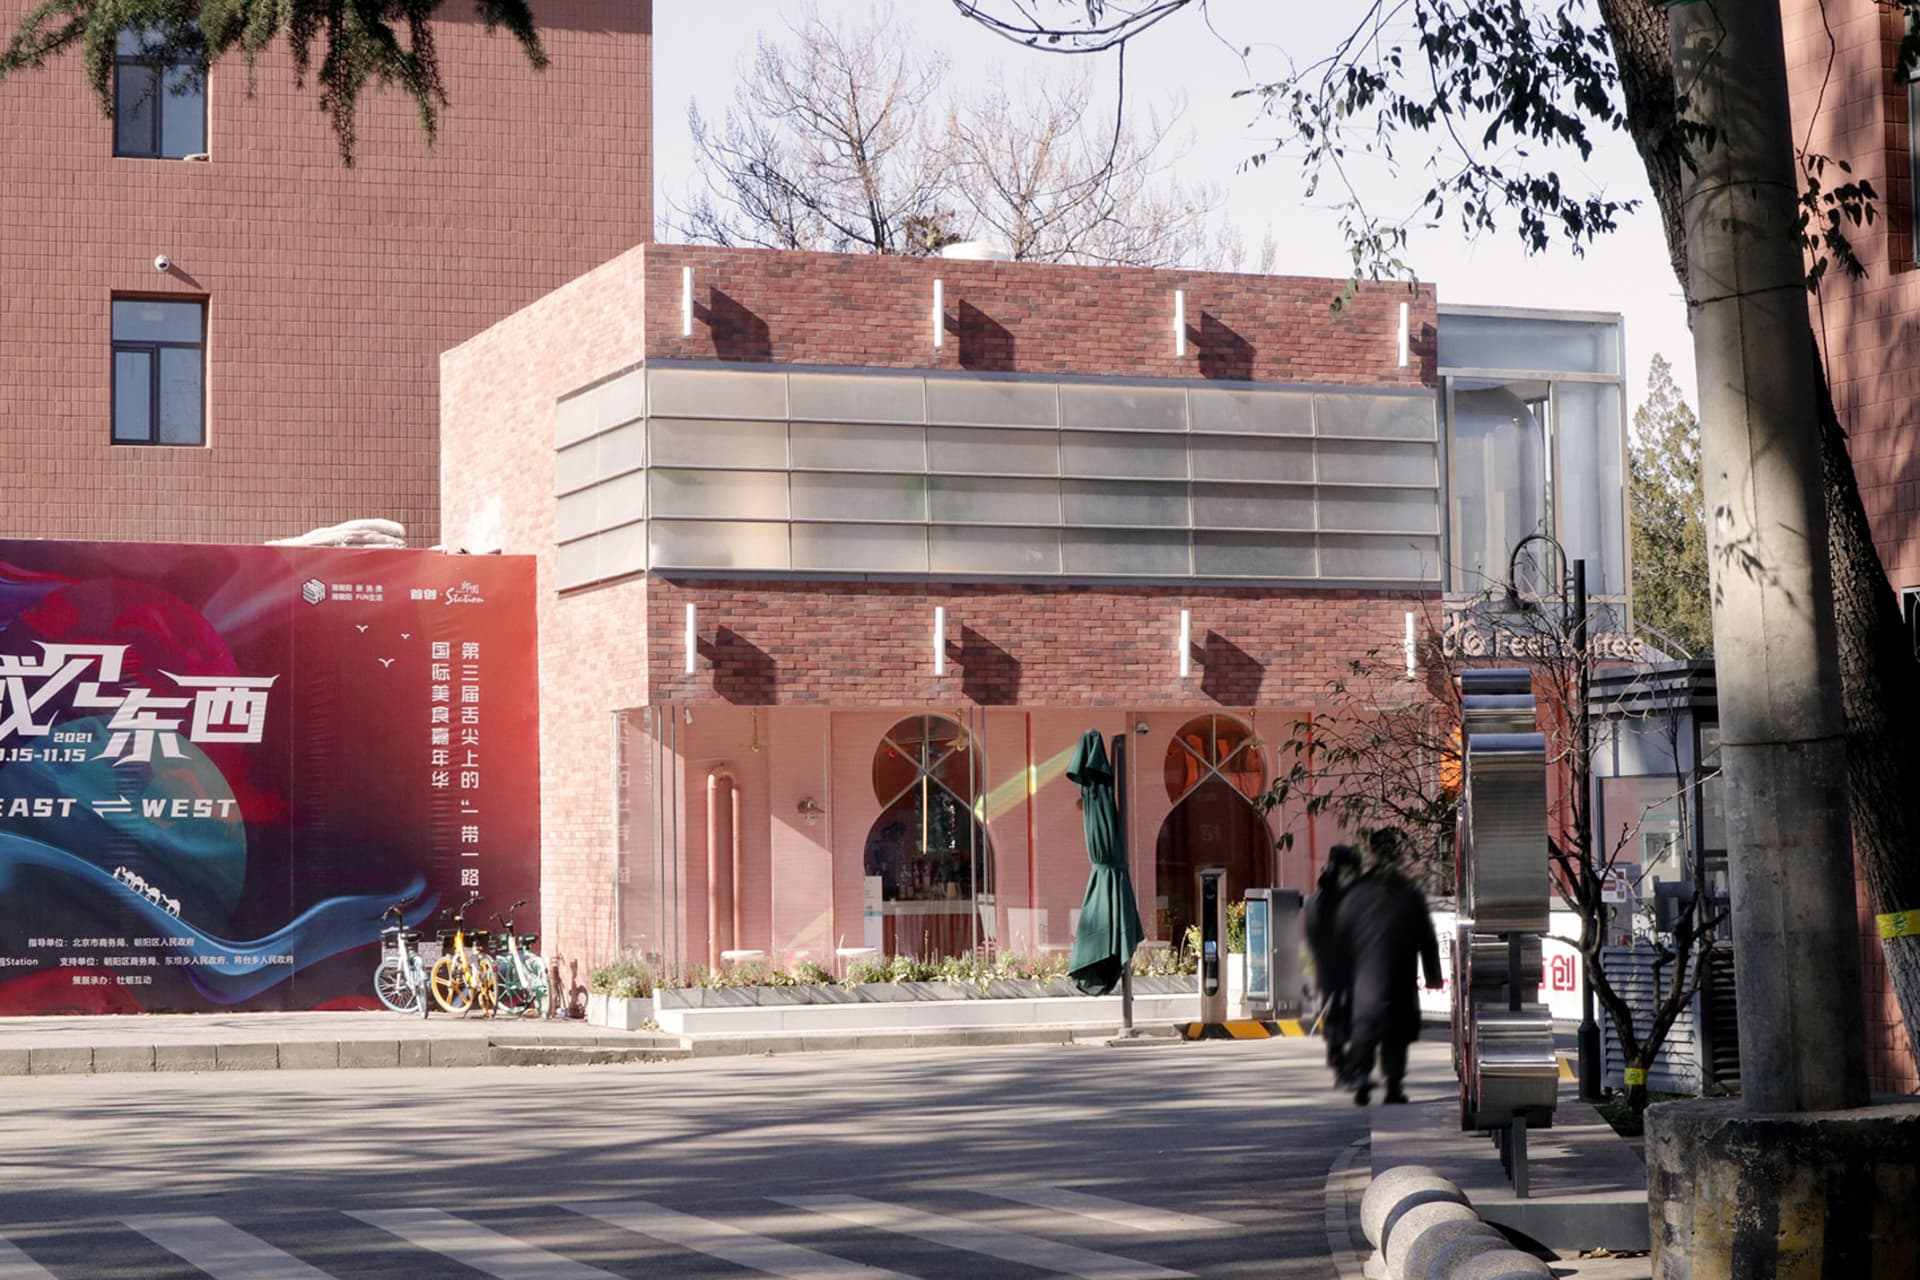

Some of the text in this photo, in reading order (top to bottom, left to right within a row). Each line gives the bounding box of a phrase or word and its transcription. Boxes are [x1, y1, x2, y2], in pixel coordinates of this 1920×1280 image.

[431, 642, 451, 788] 国际美食嘉年华
[53, 732, 92, 744] 2021
[142, 798, 236, 818] WEST
